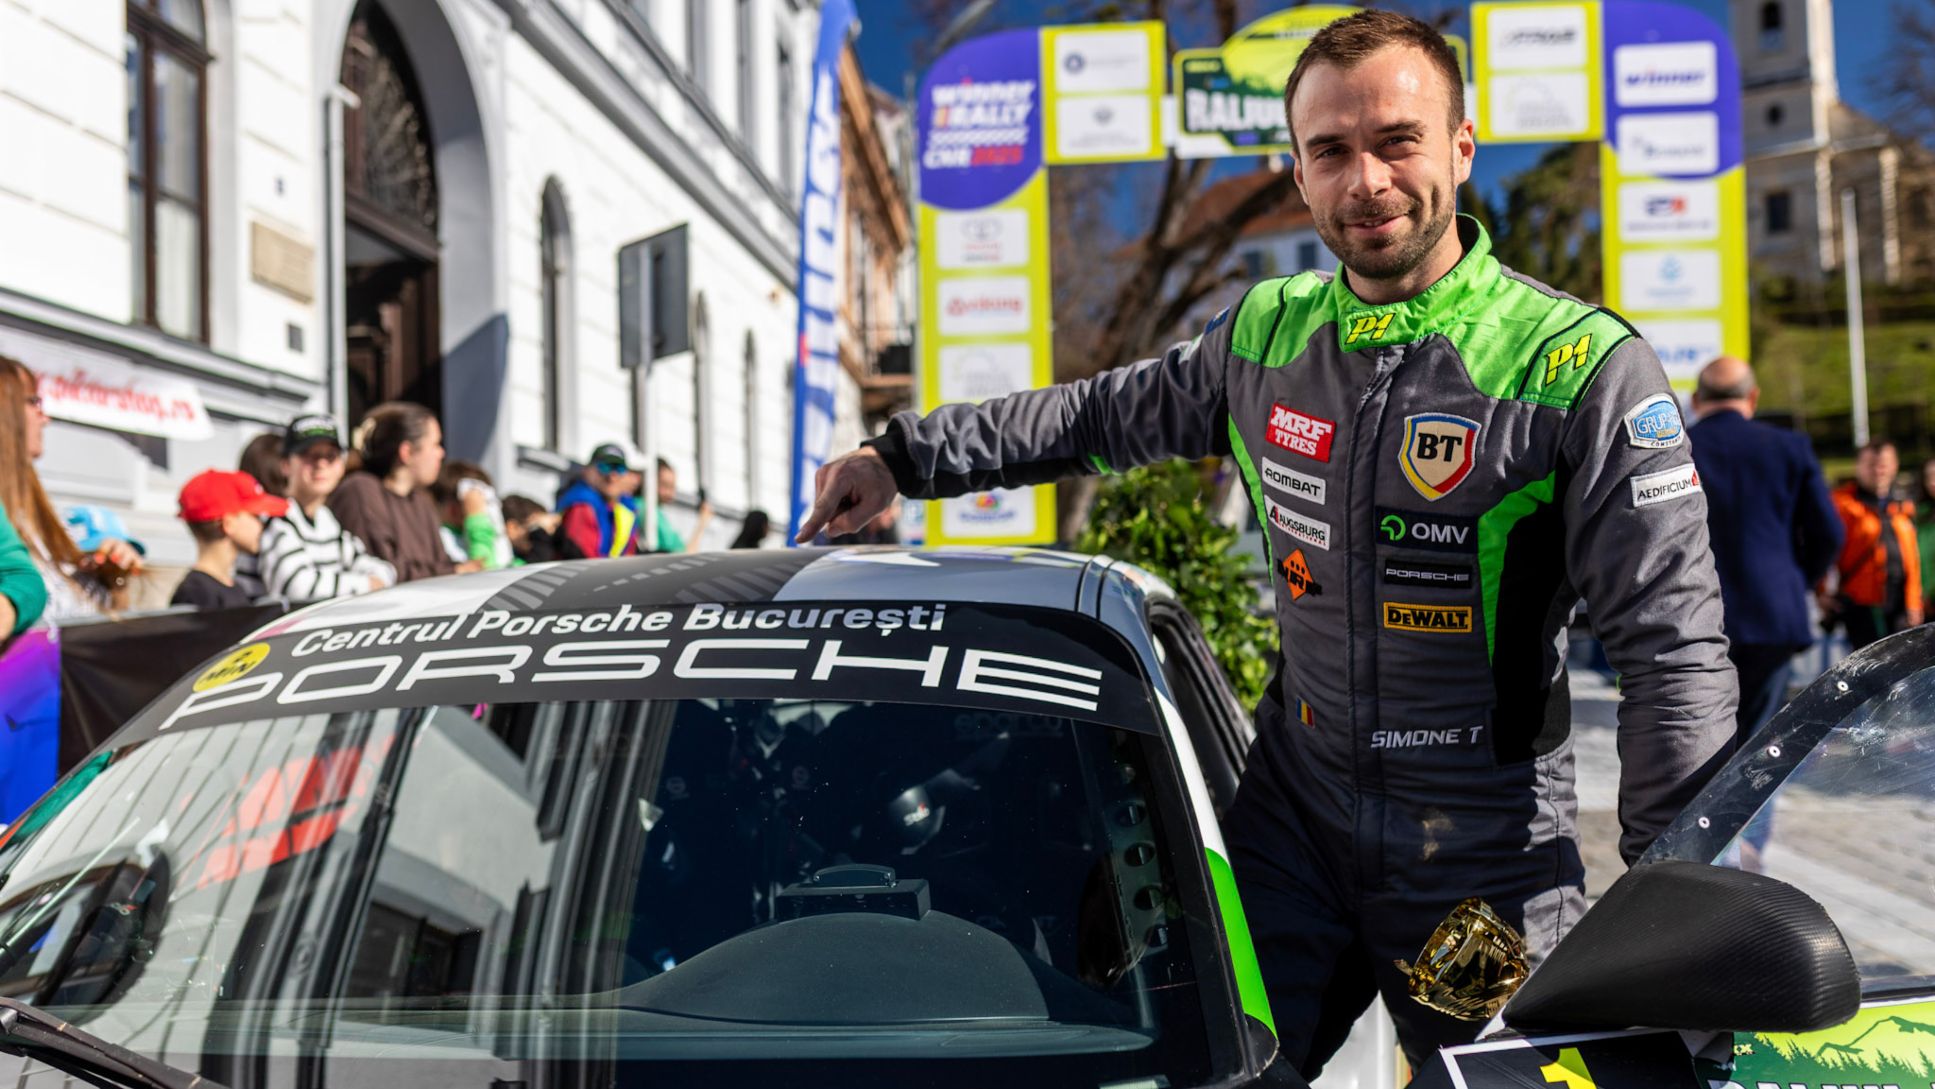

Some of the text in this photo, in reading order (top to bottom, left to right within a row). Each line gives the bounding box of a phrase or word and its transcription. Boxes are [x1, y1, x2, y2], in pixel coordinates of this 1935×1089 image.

[1345, 313, 1396, 344] P1
[1545, 333, 1592, 386] P1
[1270, 406, 1332, 441] MRF
[1275, 430, 1318, 456] TYRES
[1417, 432, 1462, 462] BT
[1265, 467, 1321, 496] ROMBAT
[1637, 478, 1693, 501] AEDIFICIUM
[1279, 513, 1326, 541] AUGSBURG
[1412, 522, 1470, 544] OMV
[1386, 568, 1470, 582] PORSCHE
[292, 603, 947, 656] Centrul Porsche București
[158, 639, 1102, 730] PORSCHE
[1370, 726, 1483, 748] SIMONE T
